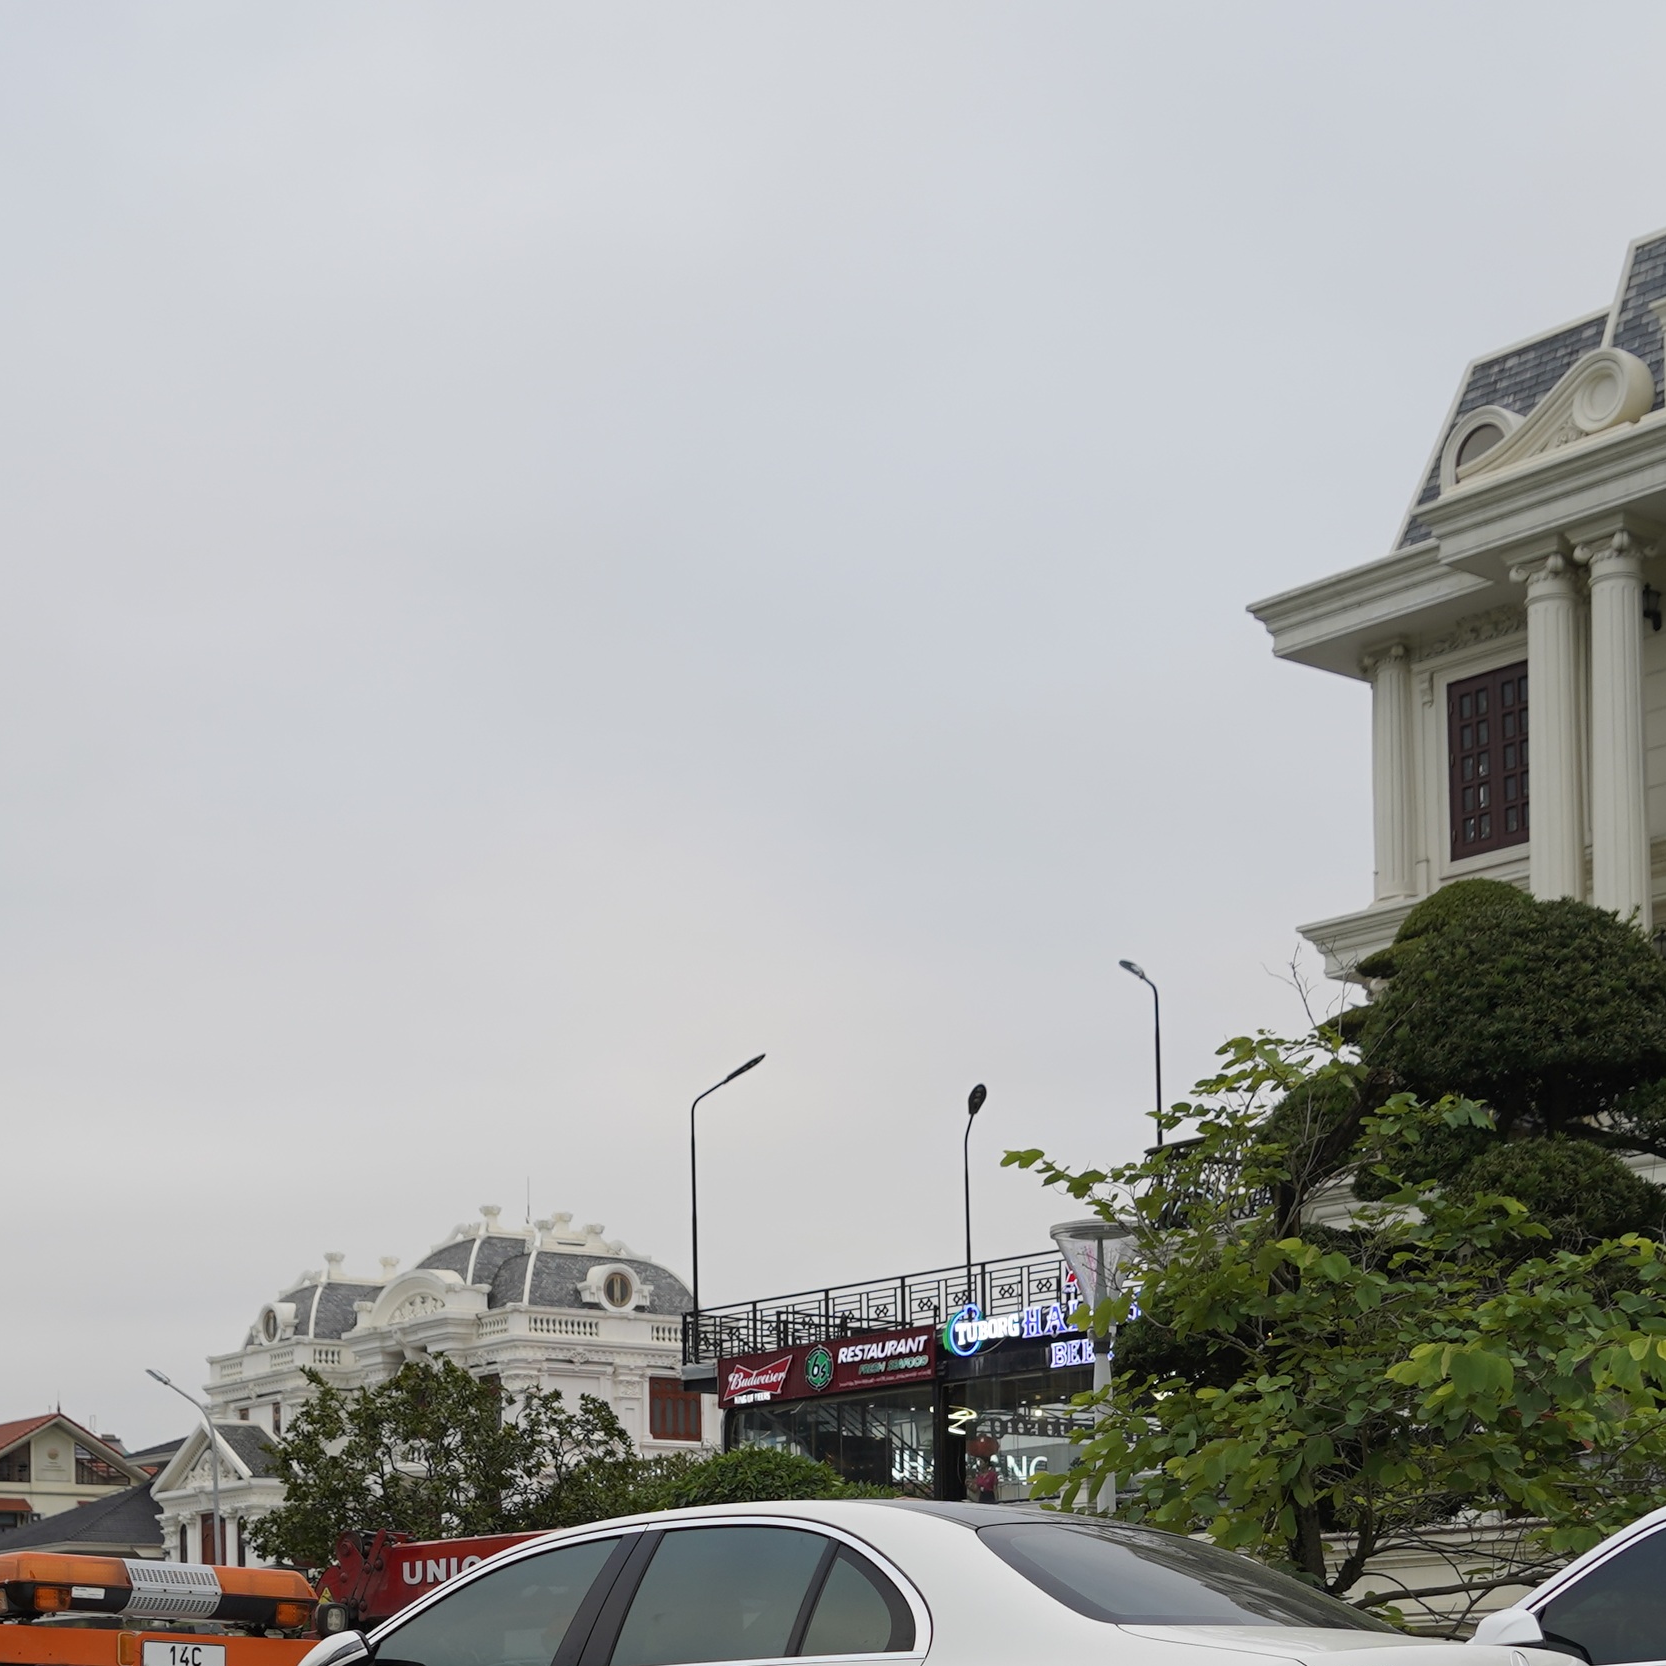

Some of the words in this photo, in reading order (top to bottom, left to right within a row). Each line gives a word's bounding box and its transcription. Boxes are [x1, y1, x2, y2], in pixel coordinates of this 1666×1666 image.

[955, 1312, 1020, 1346] TUBORG
[838, 1335, 929, 1364] RESTAURANT
[1050, 1337, 1115, 1369] BEE
[887, 1354, 929, 1371] SEAFOOD
[728, 1369, 786, 1391] Budweiser
[170, 1645, 202, 1666] 14C
